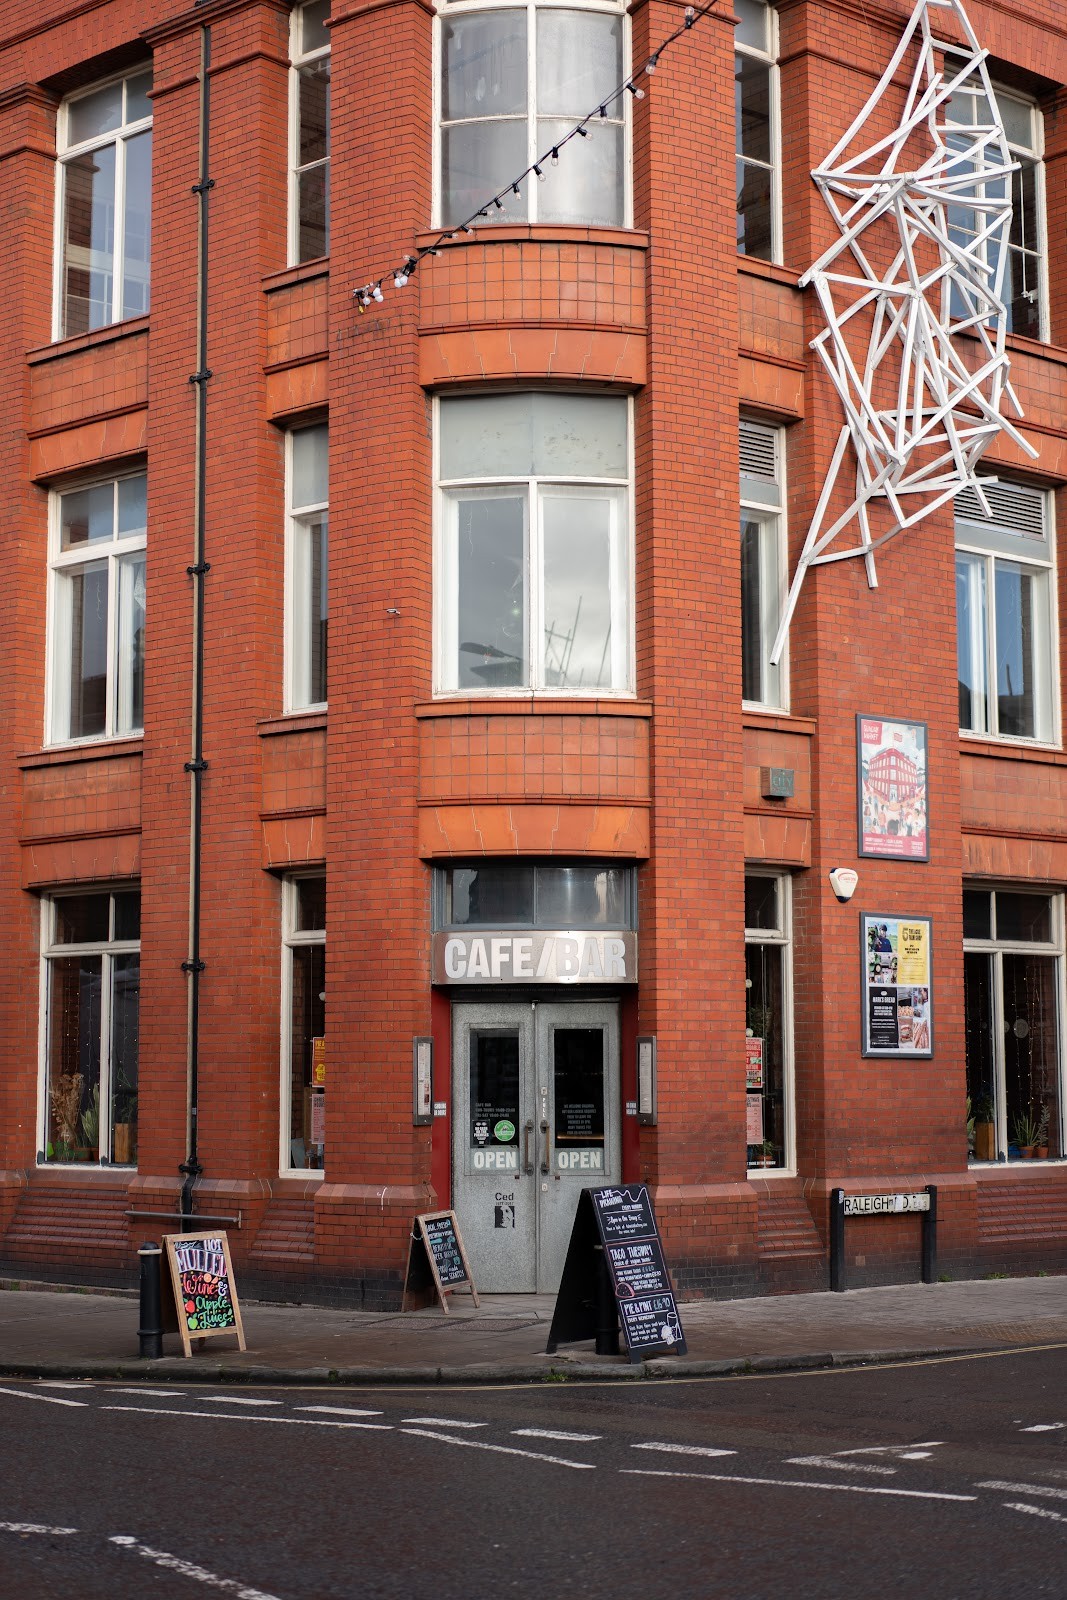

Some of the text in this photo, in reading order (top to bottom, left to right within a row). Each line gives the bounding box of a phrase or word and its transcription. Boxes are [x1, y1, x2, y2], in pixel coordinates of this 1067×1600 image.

[444, 937, 627, 978] CAFE/BAR
[473, 1151, 517, 1169] OPEN
[558, 1151, 600, 1169] OPEN
[600, 1189, 613, 1199] LIFE
[844, 1197, 889, 1212] RALEIGH
[894, 1196, 912, 1209] D.
[203, 1238, 223, 1252] HOT
[609, 1244, 654, 1261] TACO TUESDAY
[175, 1248, 228, 1278] MULLED
[183, 1272, 228, 1297] Wine &
[198, 1311, 233, 1330] Juice
